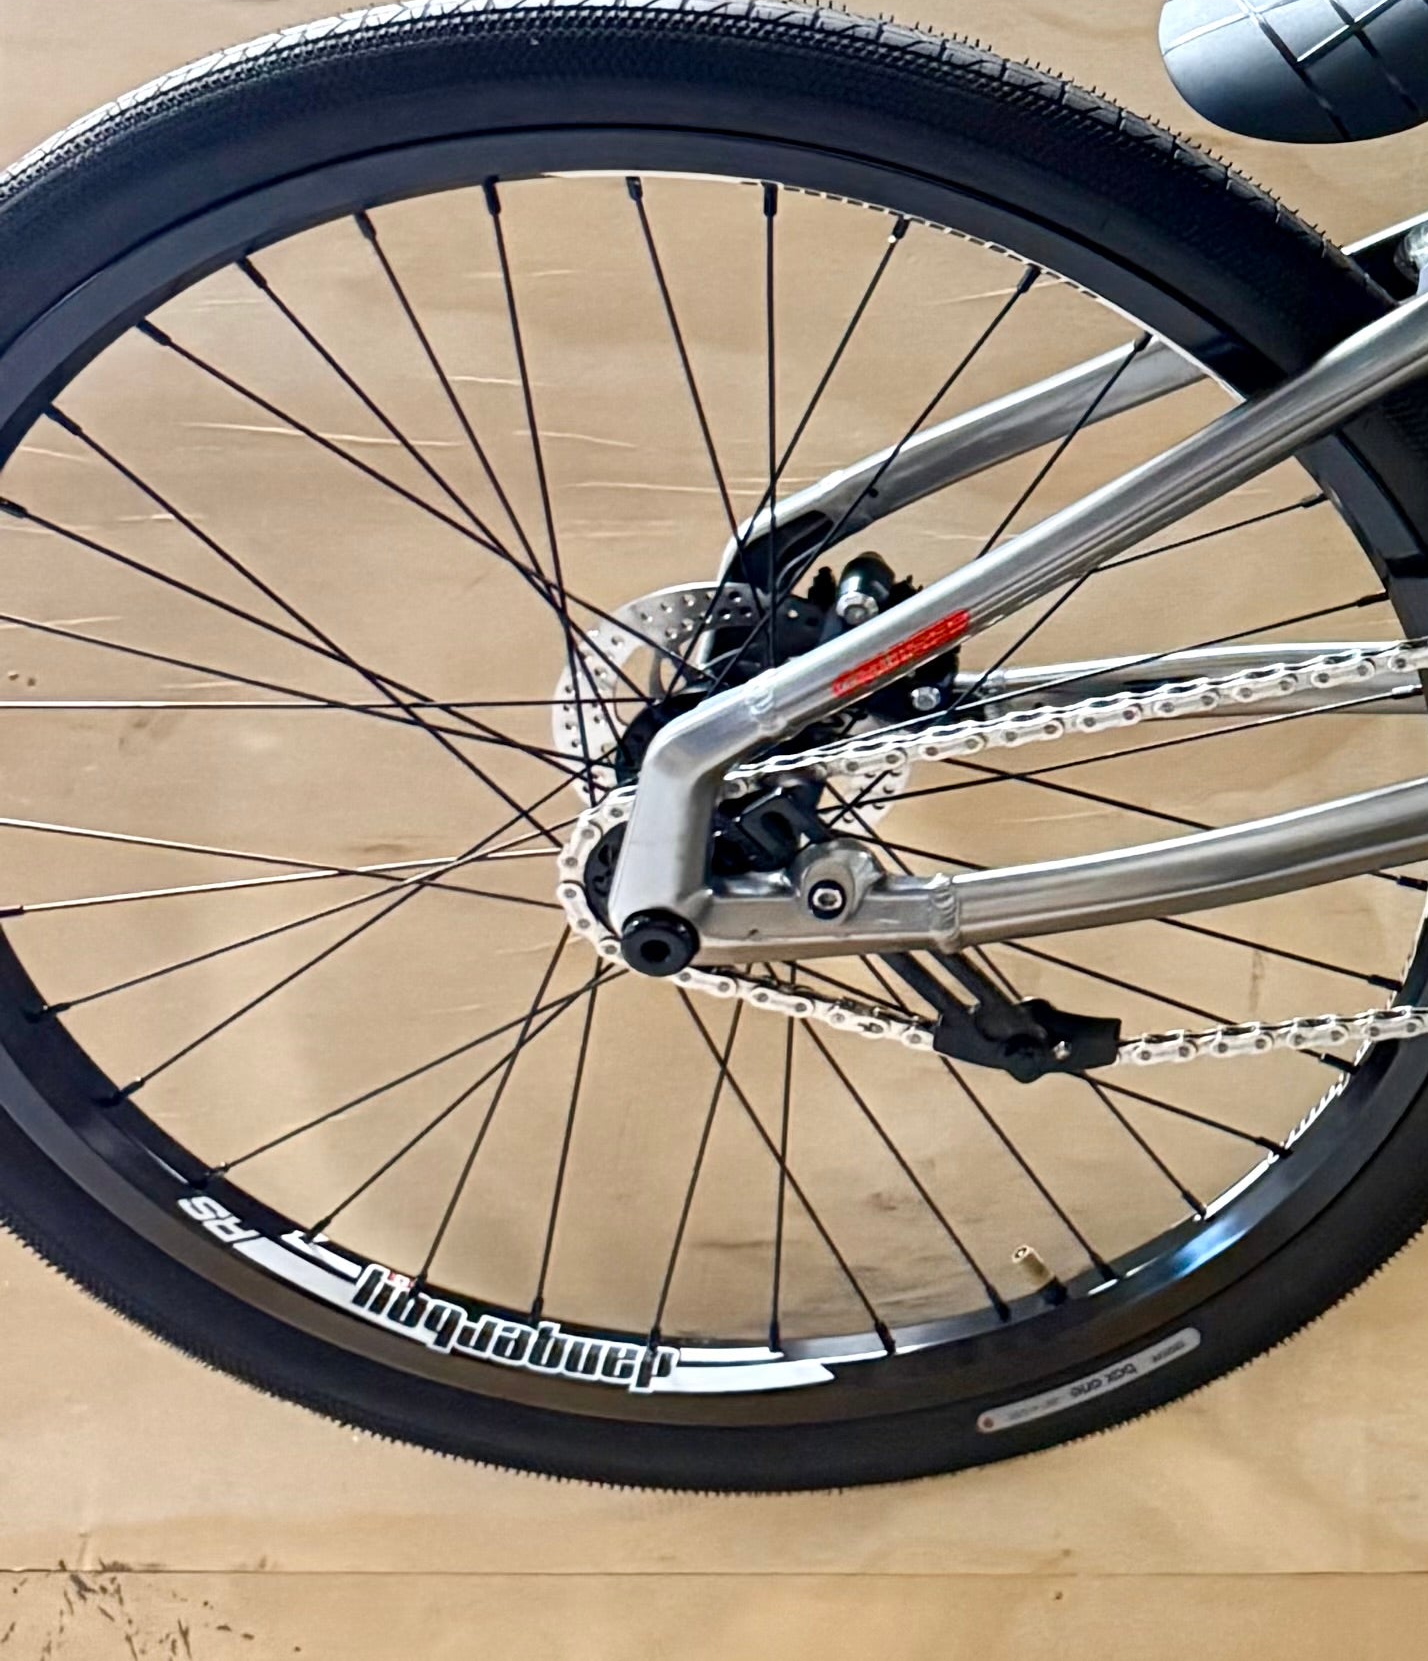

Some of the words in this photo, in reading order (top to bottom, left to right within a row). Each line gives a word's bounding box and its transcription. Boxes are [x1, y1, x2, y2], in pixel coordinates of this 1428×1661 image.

[178, 1196, 261, 1243] RS
[352, 1264, 678, 1393] dangerboy
[1069, 1379, 1103, 1398] one
[1106, 1362, 1138, 1382] box
